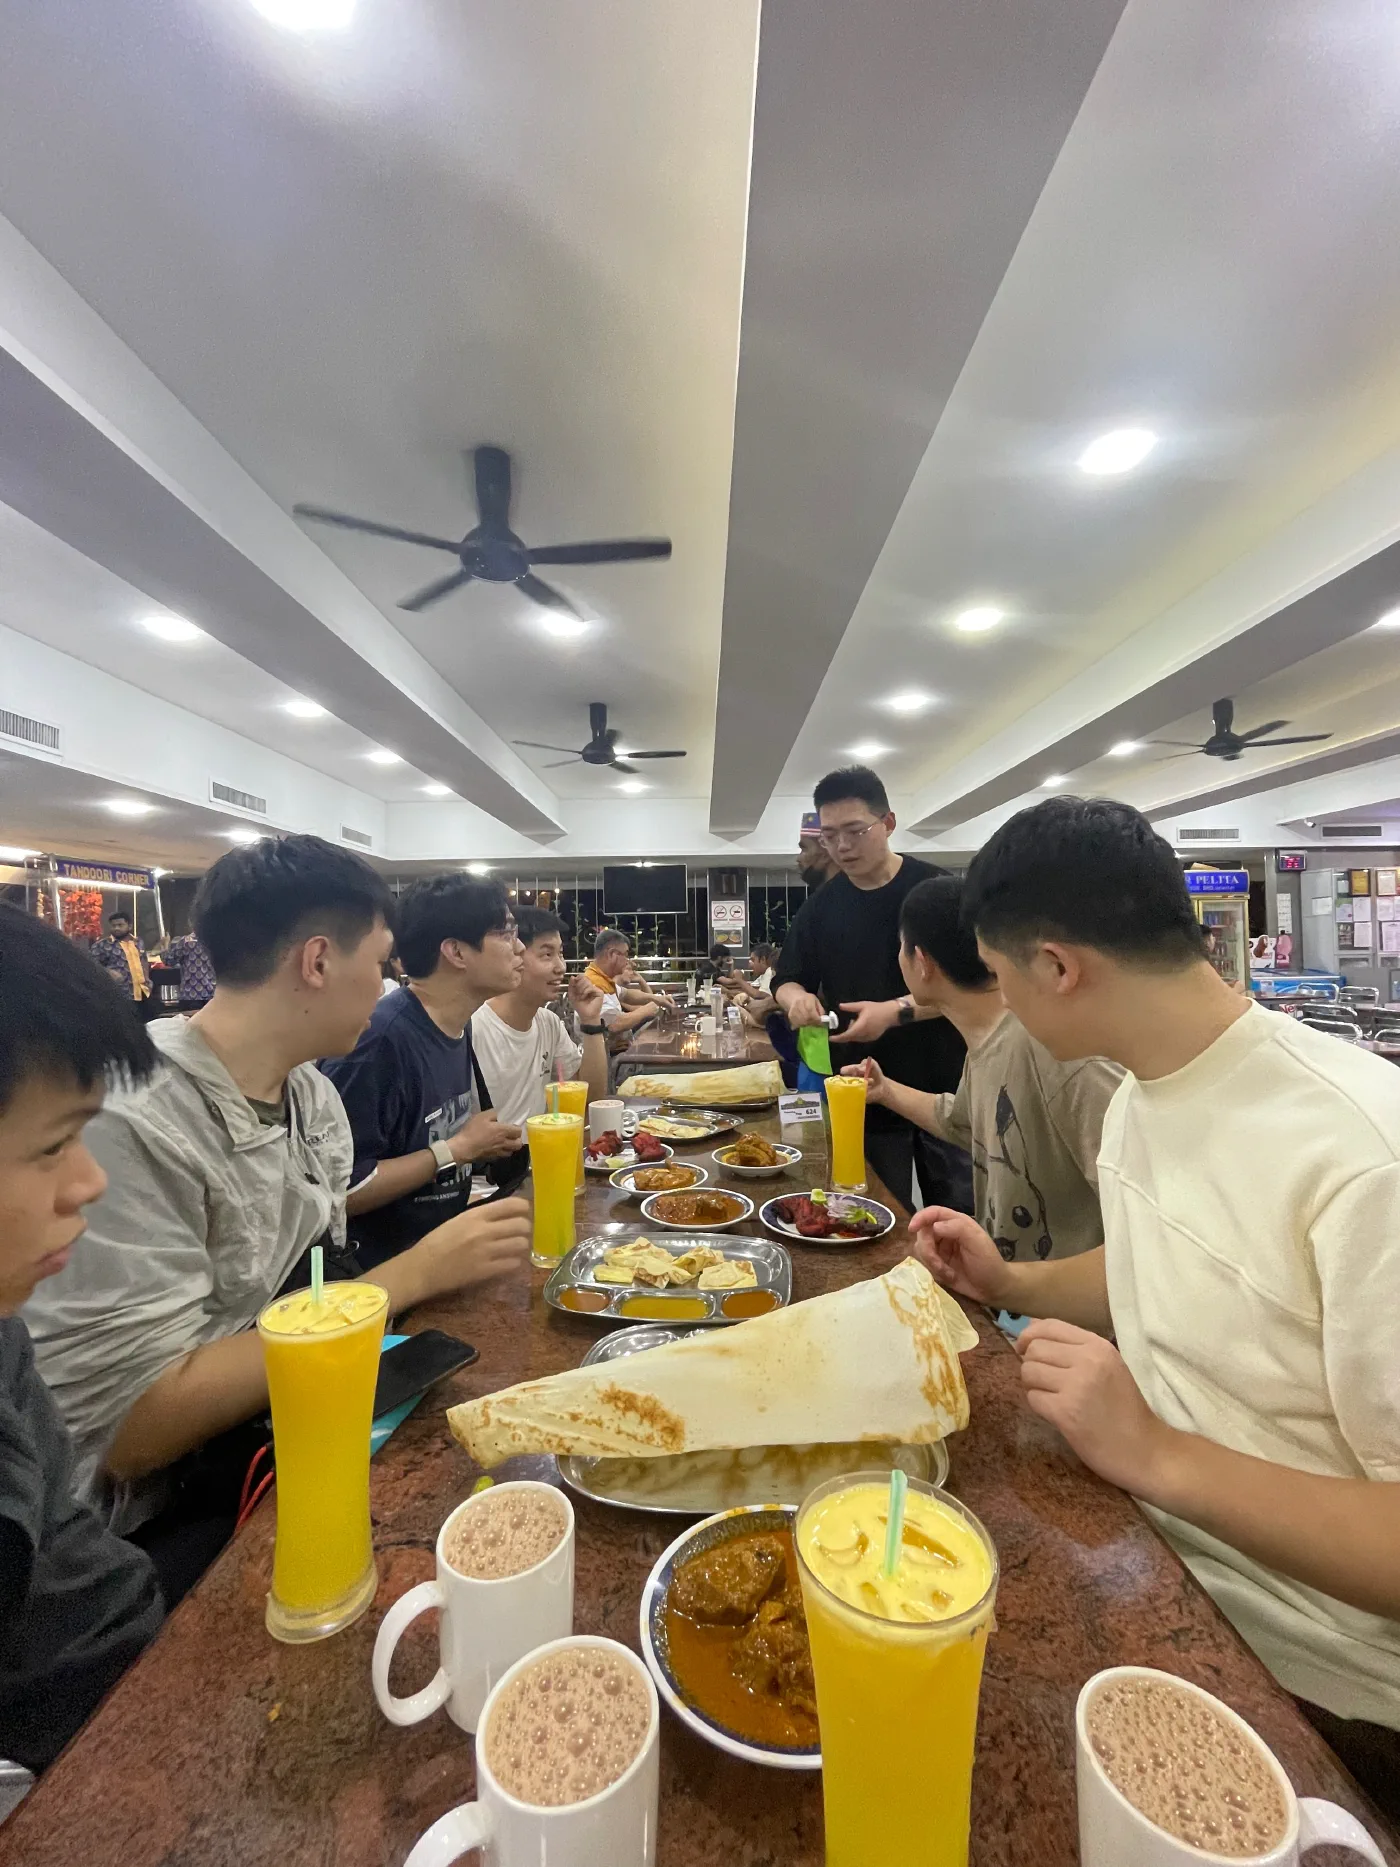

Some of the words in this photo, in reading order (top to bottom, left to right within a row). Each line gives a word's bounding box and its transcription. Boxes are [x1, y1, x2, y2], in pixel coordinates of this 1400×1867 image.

[63, 863, 113, 882] TANDOORI
[115, 870, 150, 886] CORNER
[1195, 875, 1240, 885] PELITA
